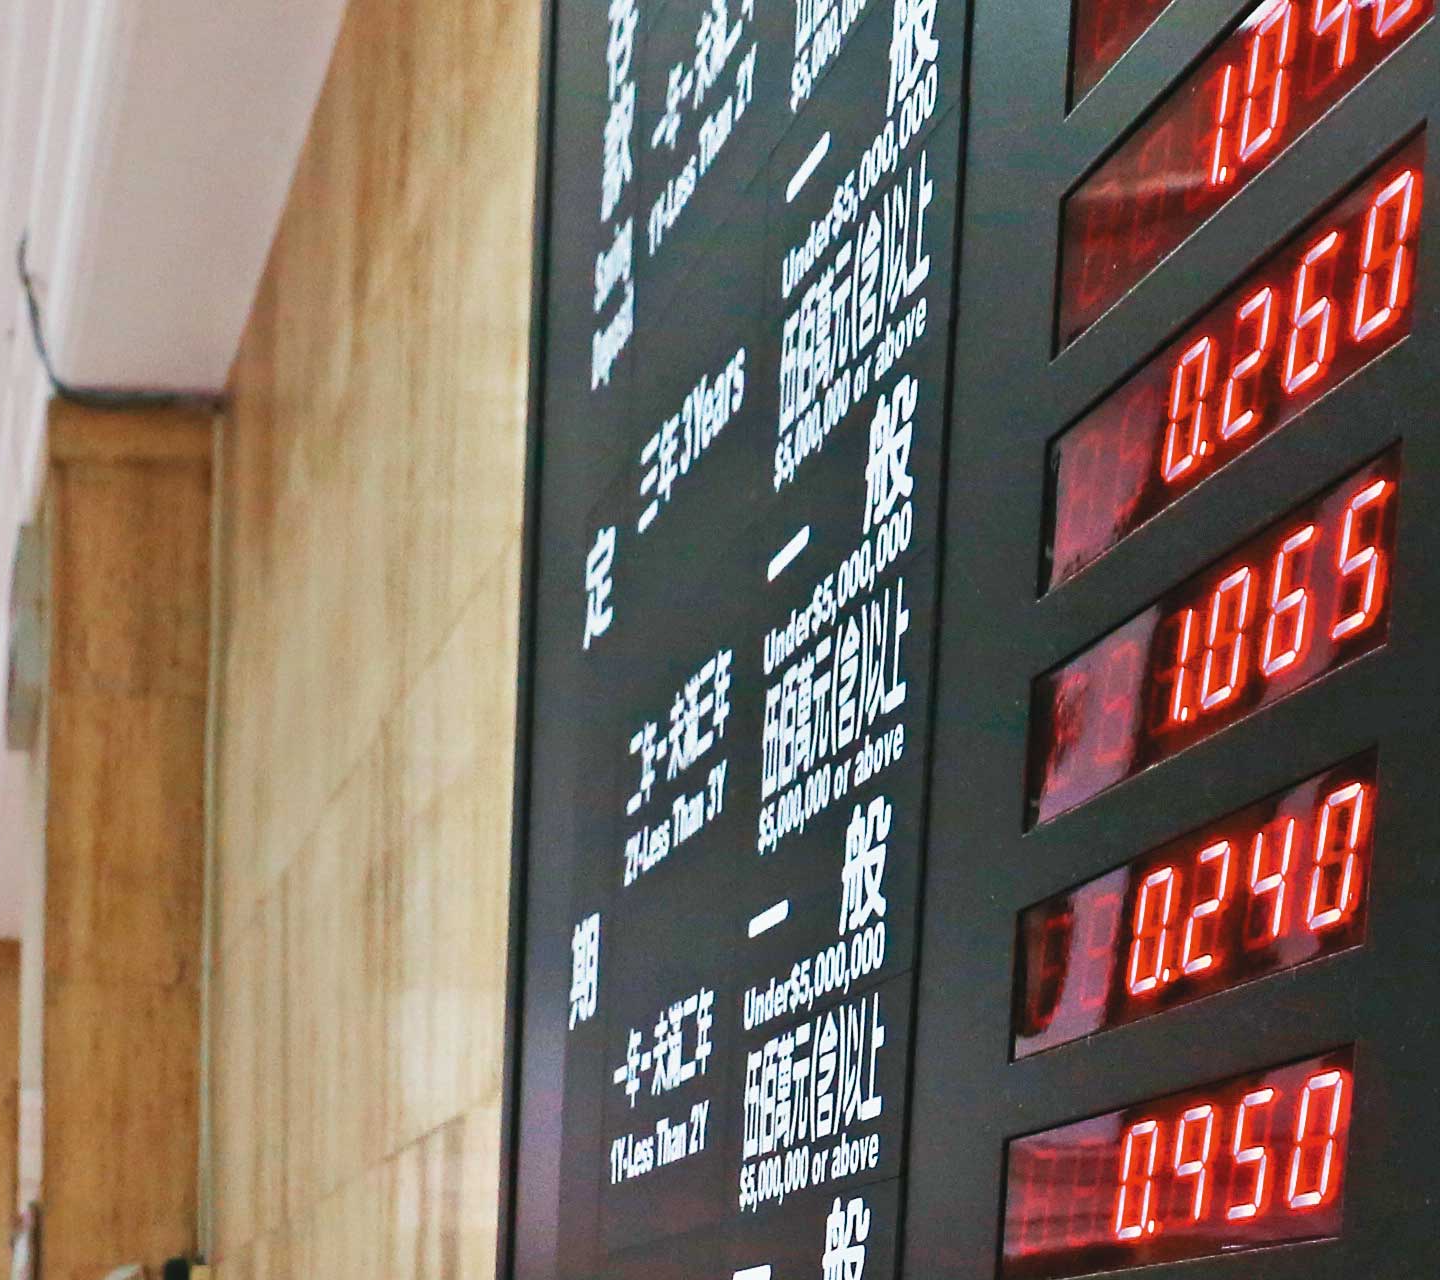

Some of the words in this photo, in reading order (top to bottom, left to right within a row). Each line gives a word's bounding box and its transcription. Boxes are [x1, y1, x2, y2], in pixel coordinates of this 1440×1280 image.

[791, 0, 866, 113] $5,000,00
[1210, 0, 1416, 187] 1.0
[782, 63, 938, 298] Under$5,000,000
[773, 382, 849, 493] $5,000,000
[854, 365, 871, 402] or
[874, 297, 927, 381] above
[1161, 170, 1415, 483] 0.260
[763, 501, 912, 675] Under$5,000,000
[1173, 479, 1387, 722] 1.065
[623, 811, 670, 887] 2Y-Less
[671, 786, 706, 850] Than
[706, 759, 727, 825] 3Y
[757, 776, 831, 855] $5,000,000
[833, 767, 849, 800] or
[854, 723, 905, 793] above
[1126, 782, 1363, 997] 0.240
[743, 921, 886, 1032] Under$5,000,000
[610, 1130, 655, 1185] 1Y-Less
[656, 1116, 688, 1169] Than
[689, 1100, 710, 1153] 2Y
[739, 1150, 810, 1212] $5,000,000
[811, 1149, 828, 1185] or
[831, 1131, 880, 1178] above
[1115, 1070, 1342, 1241] 0.950
